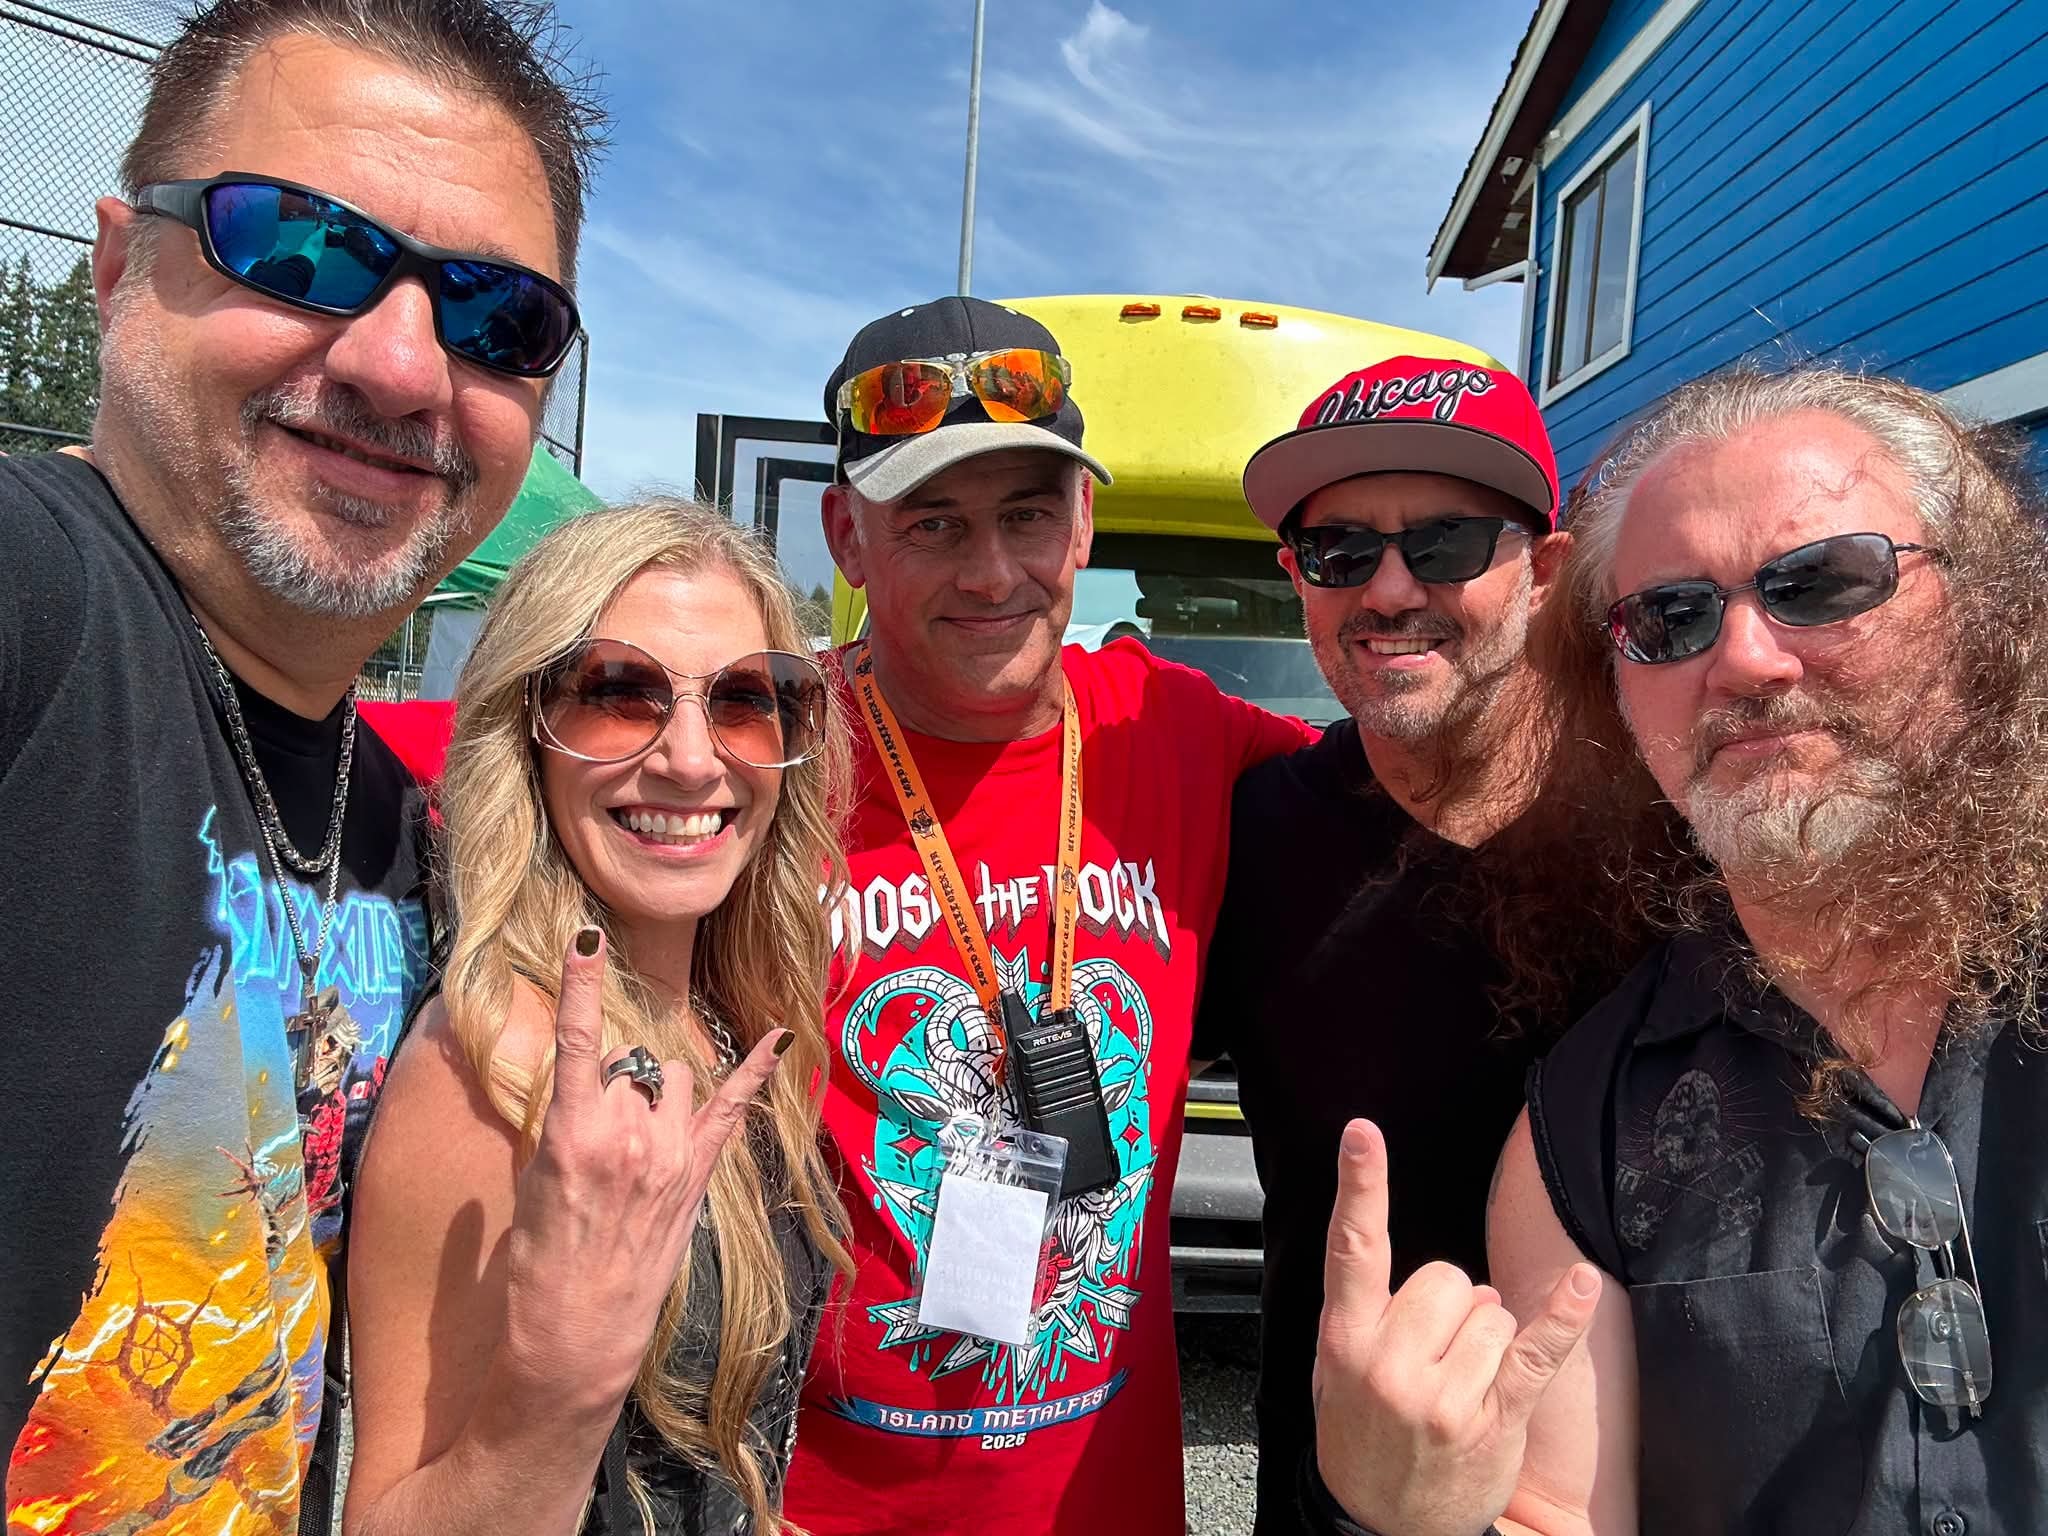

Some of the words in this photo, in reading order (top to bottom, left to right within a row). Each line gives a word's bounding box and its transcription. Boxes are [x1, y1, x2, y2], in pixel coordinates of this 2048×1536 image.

[1315, 368, 1496, 424] Chicago
[1032, 1030, 1073, 1047] RETEVIS
[879, 1408, 973, 1431] ISLAND
[984, 1385, 1112, 1428] METALFEST
